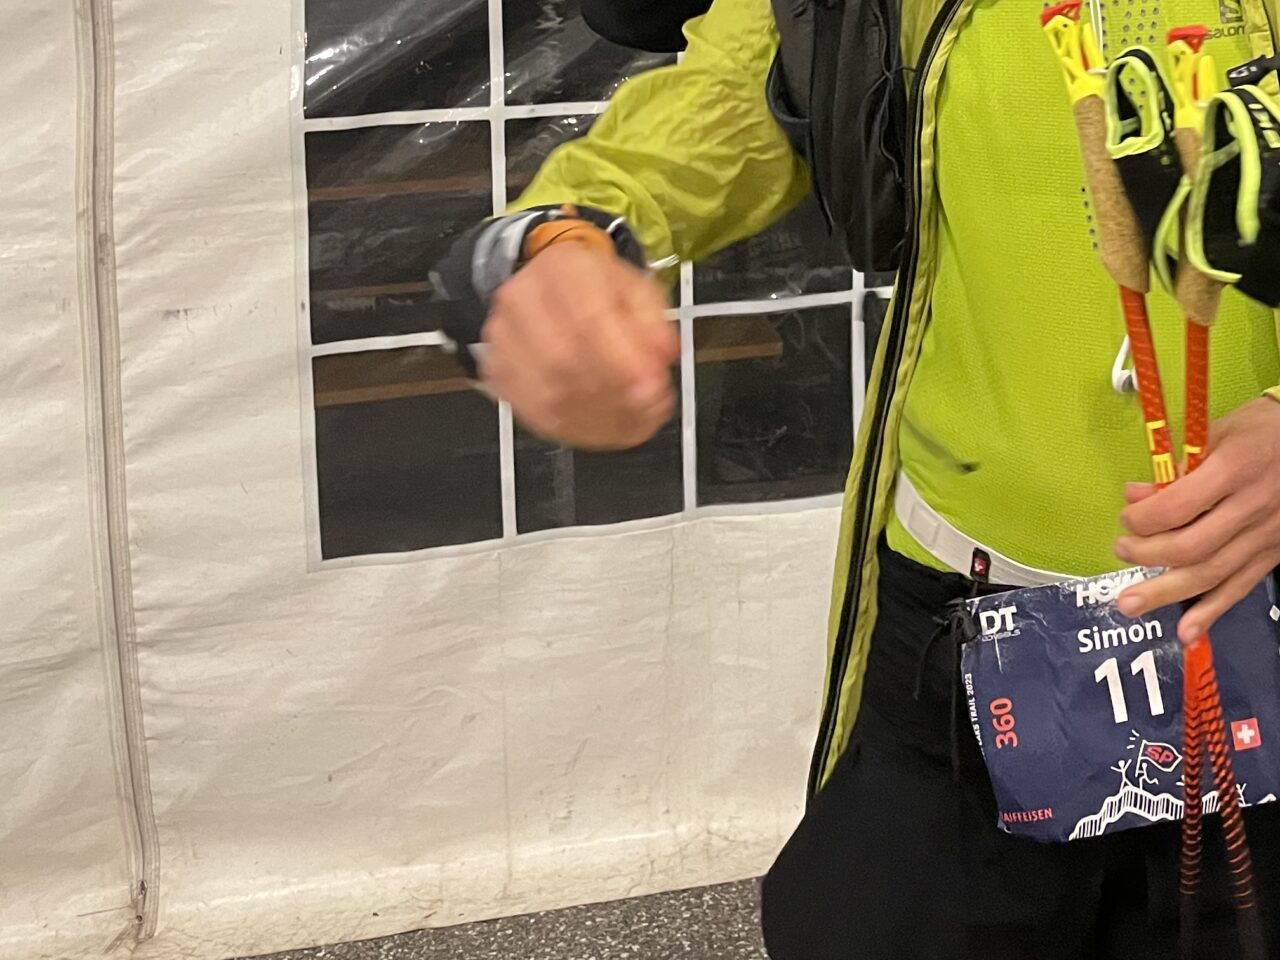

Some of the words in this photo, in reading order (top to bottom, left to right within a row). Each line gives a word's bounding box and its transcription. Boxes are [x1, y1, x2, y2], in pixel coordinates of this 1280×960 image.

[980, 605, 1018, 636] DT
[1077, 620, 1163, 653] Simon
[964, 673, 974, 696] 2023
[1094, 650, 1165, 724] 11
[990, 697, 1019, 749] 360
